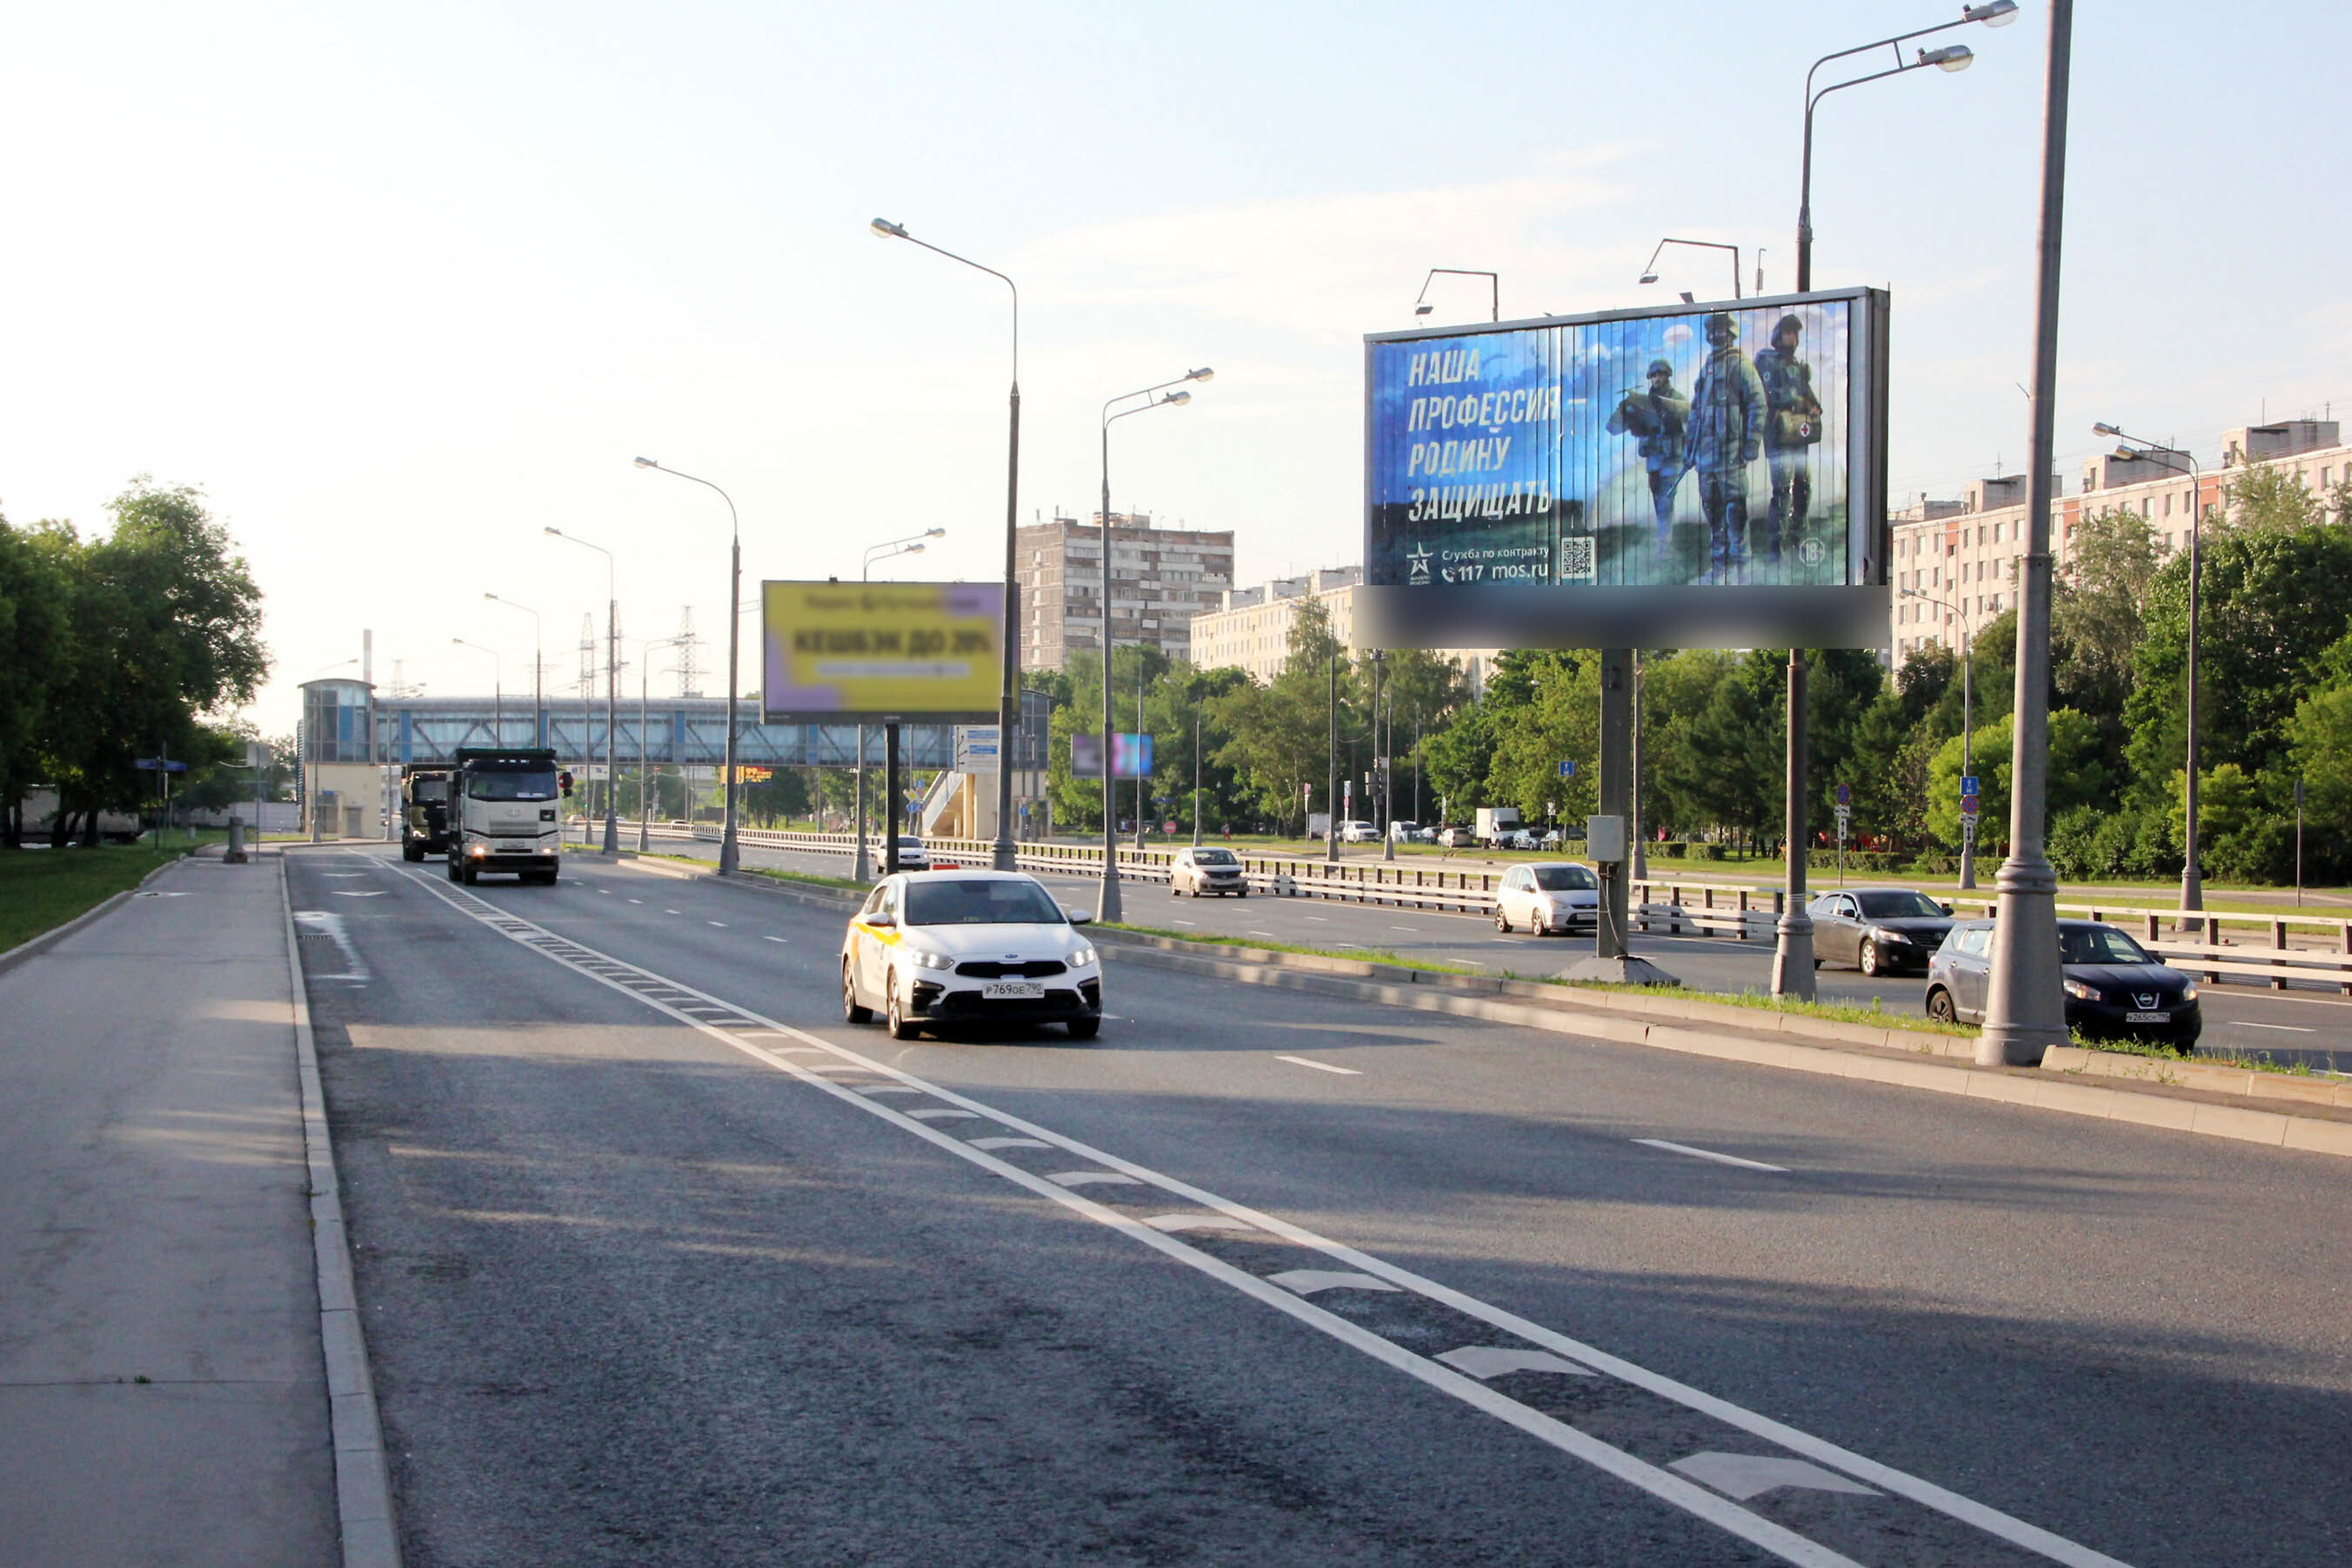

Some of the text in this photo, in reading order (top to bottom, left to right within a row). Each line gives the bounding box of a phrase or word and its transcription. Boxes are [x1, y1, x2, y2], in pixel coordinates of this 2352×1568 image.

[1407, 348, 1480, 388] НАША
[1407, 385, 1562, 432] ПРОФЕССИЯ
[1407, 436, 1513, 478] РОДИНУ
[1407, 479, 1553, 523] ЗАЩИЩАТЬ
[1441, 547, 1549, 563] Служба по контракту
[1457, 563, 1548, 582] 117 mos.ru
